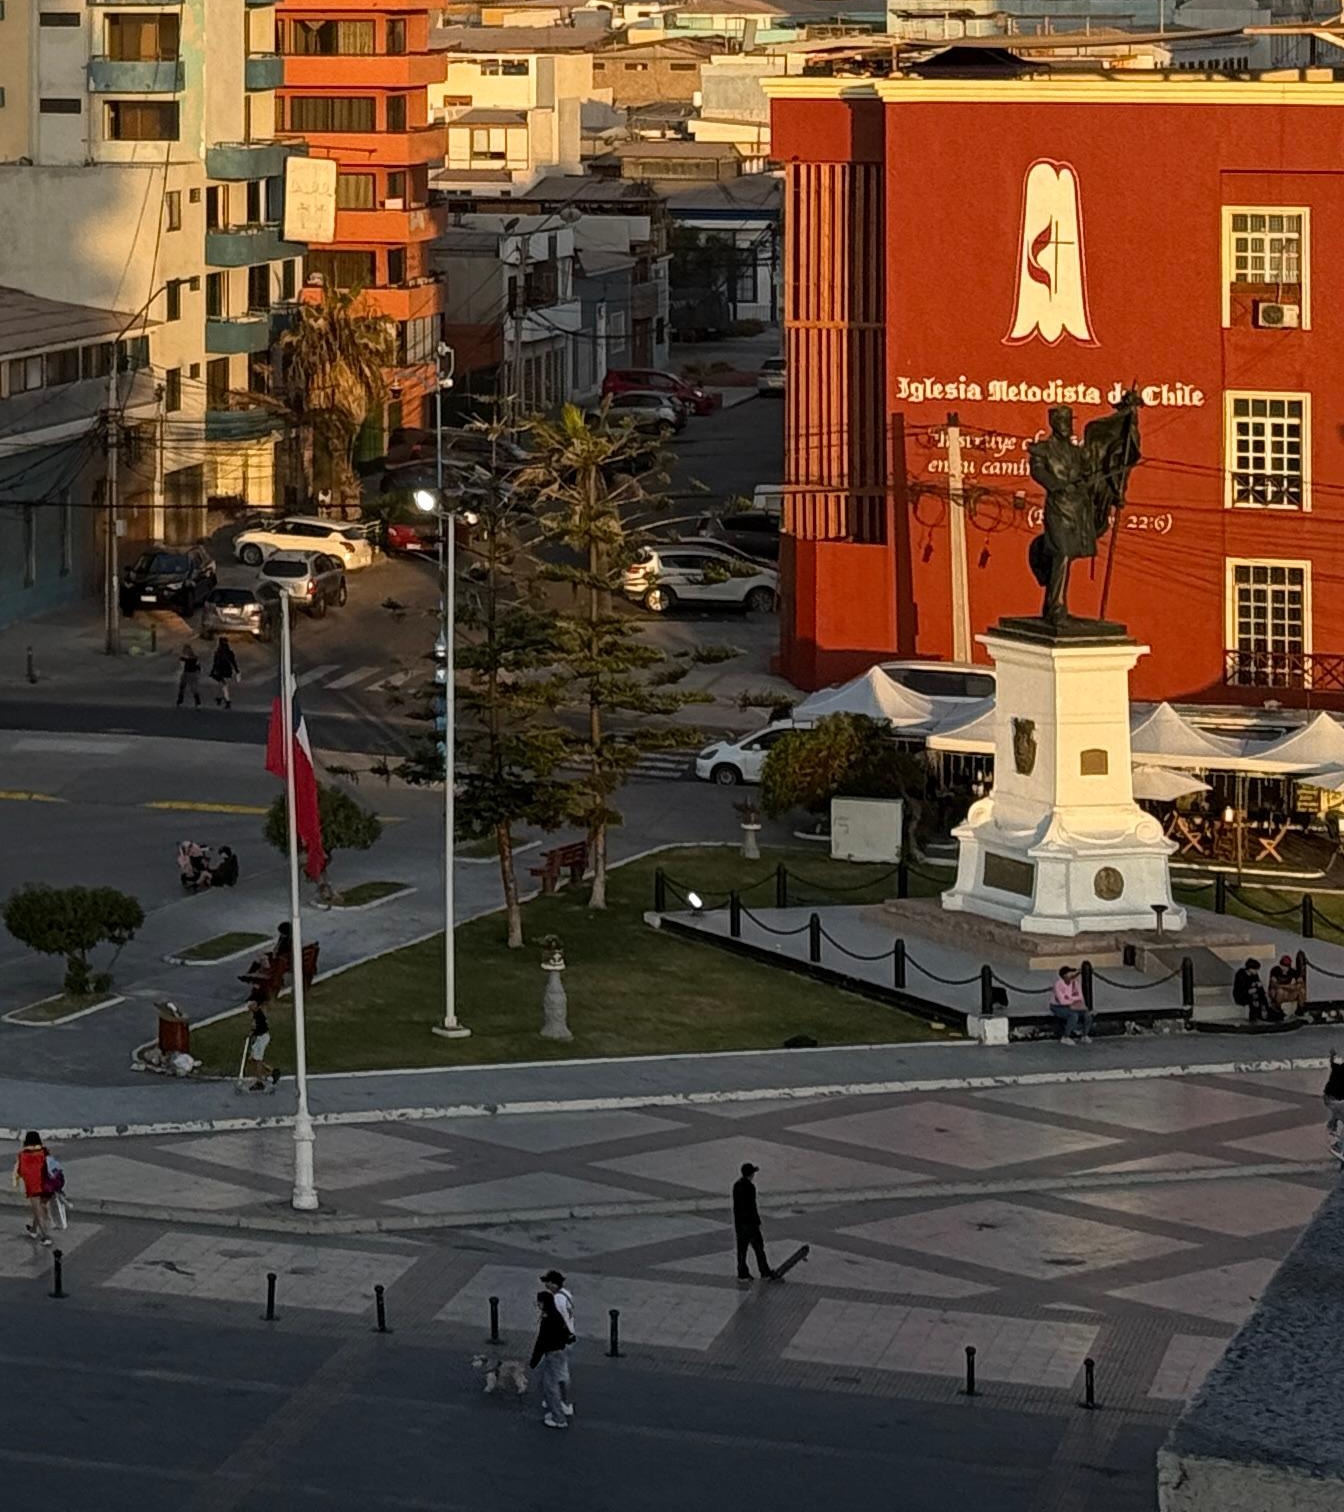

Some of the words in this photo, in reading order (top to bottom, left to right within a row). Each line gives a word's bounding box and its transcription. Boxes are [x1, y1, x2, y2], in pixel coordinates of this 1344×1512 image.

[896, 375, 983, 402] Iglesia
[987, 379, 1102, 405] Metodista
[1141, 381, 1206, 407] Chile
[1127, 513, 1173, 534] 22:6)
